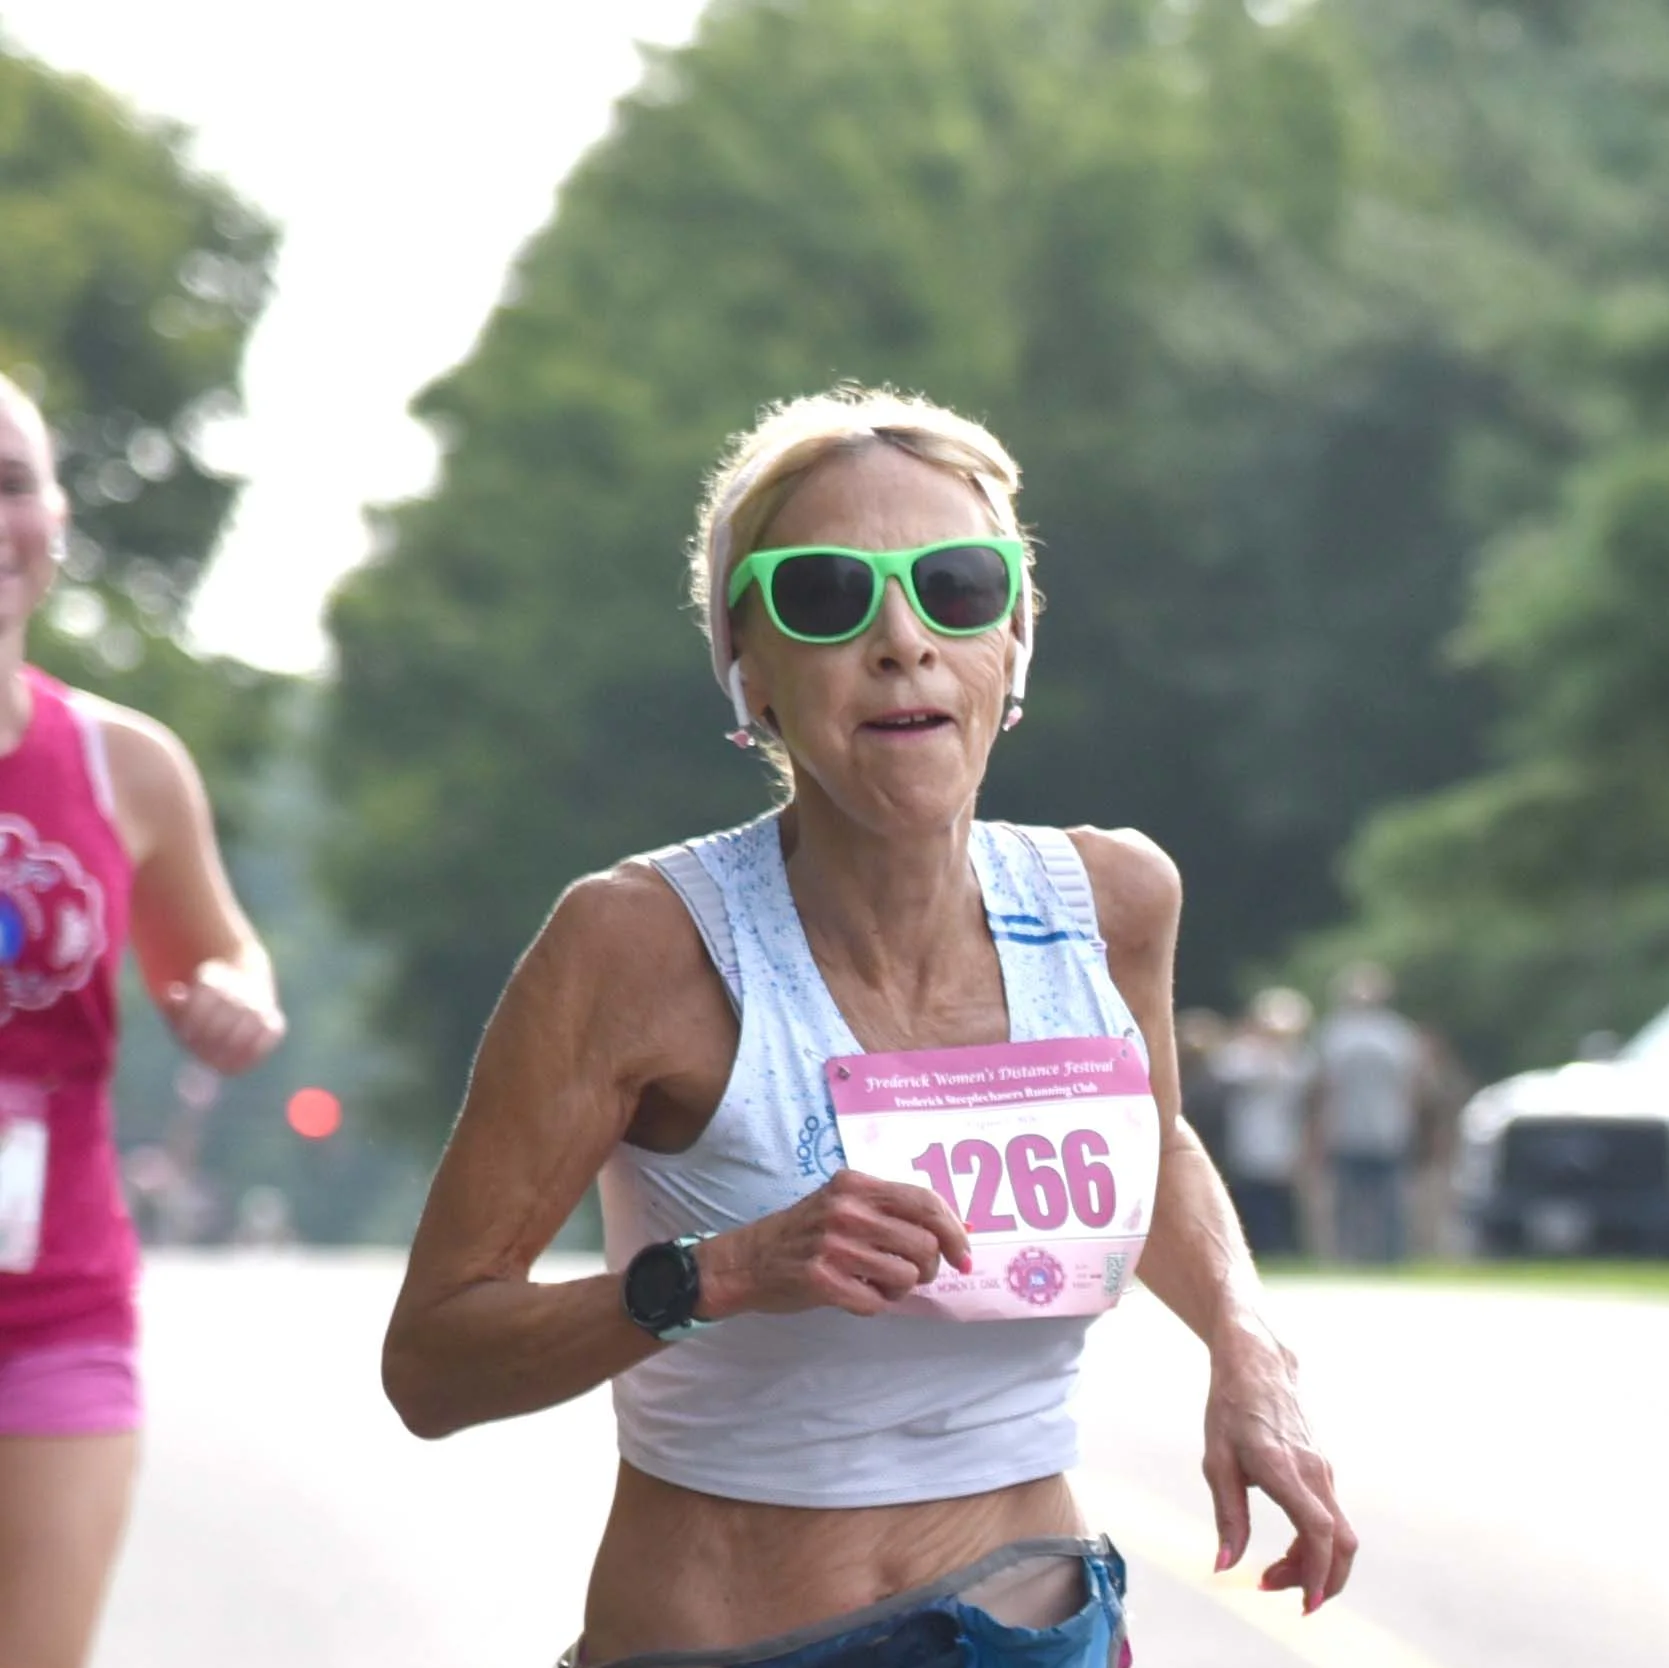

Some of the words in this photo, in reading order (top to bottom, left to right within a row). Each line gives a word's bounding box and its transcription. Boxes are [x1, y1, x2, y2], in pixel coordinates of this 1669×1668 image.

[864, 1073, 930, 1093] Frederick
[932, 1067, 995, 1086] Women's
[998, 1064, 1059, 1080] Distance
[1064, 1058, 1115, 1077] Festival
[1024, 1085, 1073, 1099] Running
[1073, 1081, 1098, 1093] Club
[797, 1115, 820, 1177] HOCO
[911, 1128, 1116, 1234] 1266
